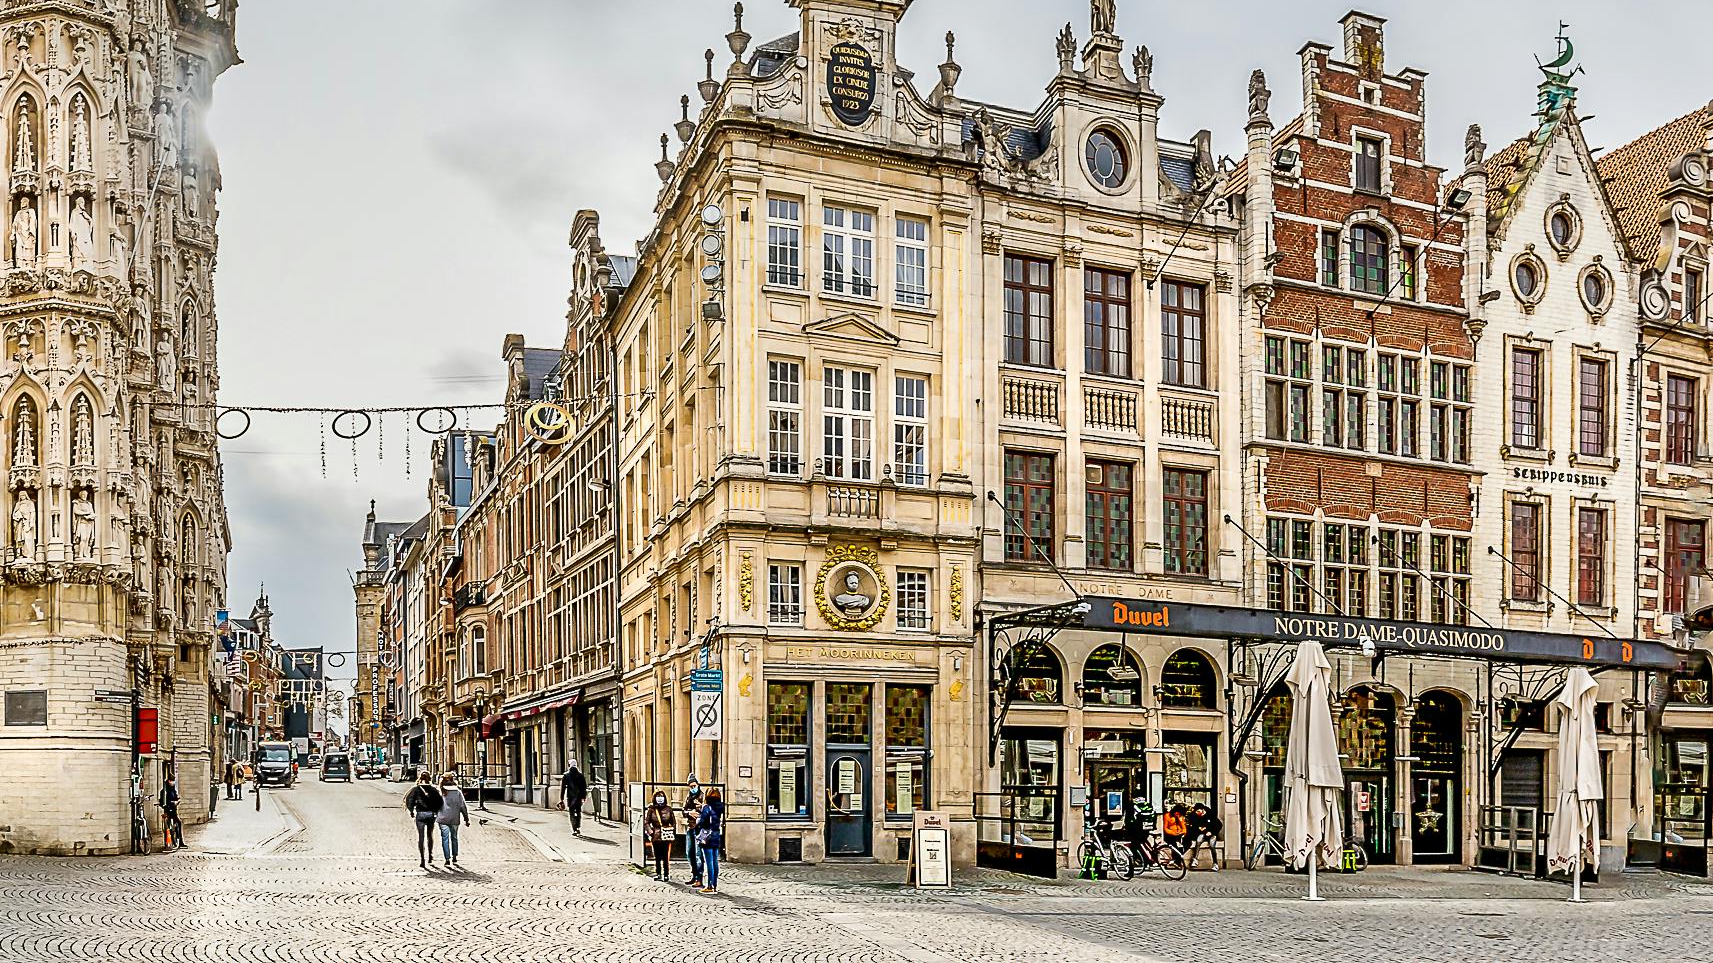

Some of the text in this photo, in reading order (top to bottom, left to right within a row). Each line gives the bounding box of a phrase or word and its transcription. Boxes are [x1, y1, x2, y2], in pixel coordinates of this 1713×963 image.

[842, 100, 860, 109] 1923
[1080, 584, 1124, 596] NOTRE
[1139, 587, 1174, 599] DAME
[1112, 601, 1170, 627] Duvel
[1274, 617, 1504, 651] NOTRE DAME-QUASIMODO
[788, 647, 915, 661] HET MOORINNEKEN
